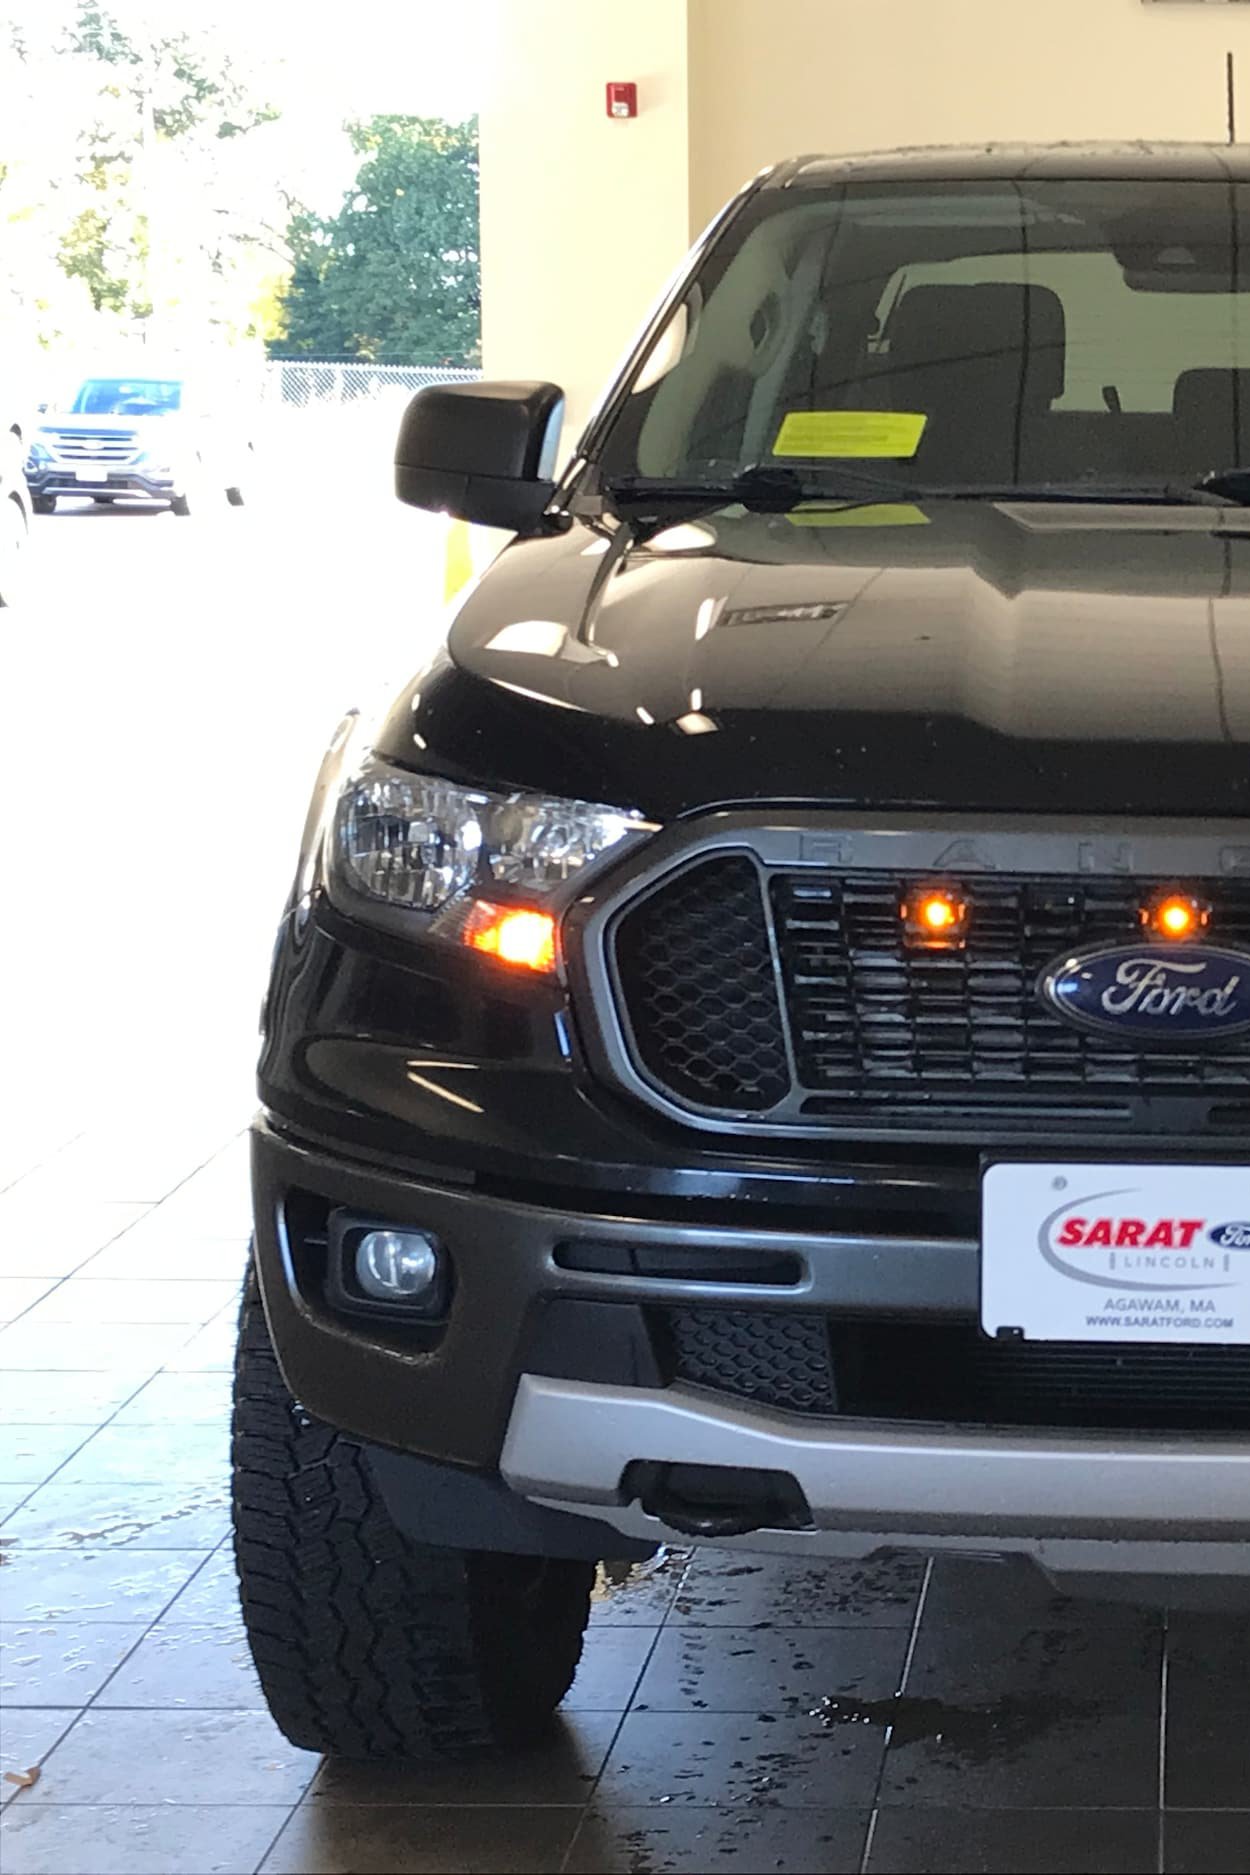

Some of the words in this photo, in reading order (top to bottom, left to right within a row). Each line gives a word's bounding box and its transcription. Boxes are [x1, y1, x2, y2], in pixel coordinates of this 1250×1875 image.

[1102, 958, 1240, 1016] Ford
[1058, 1218, 1204, 1248] SARAT
[1124, 1255, 1216, 1269] LINCOLN
[1104, 1298, 1184, 1314] AGAWAM,
[1190, 1299, 1216, 1313] MA
[1086, 1315, 1234, 1329] WWW.SARATFORD.COM
